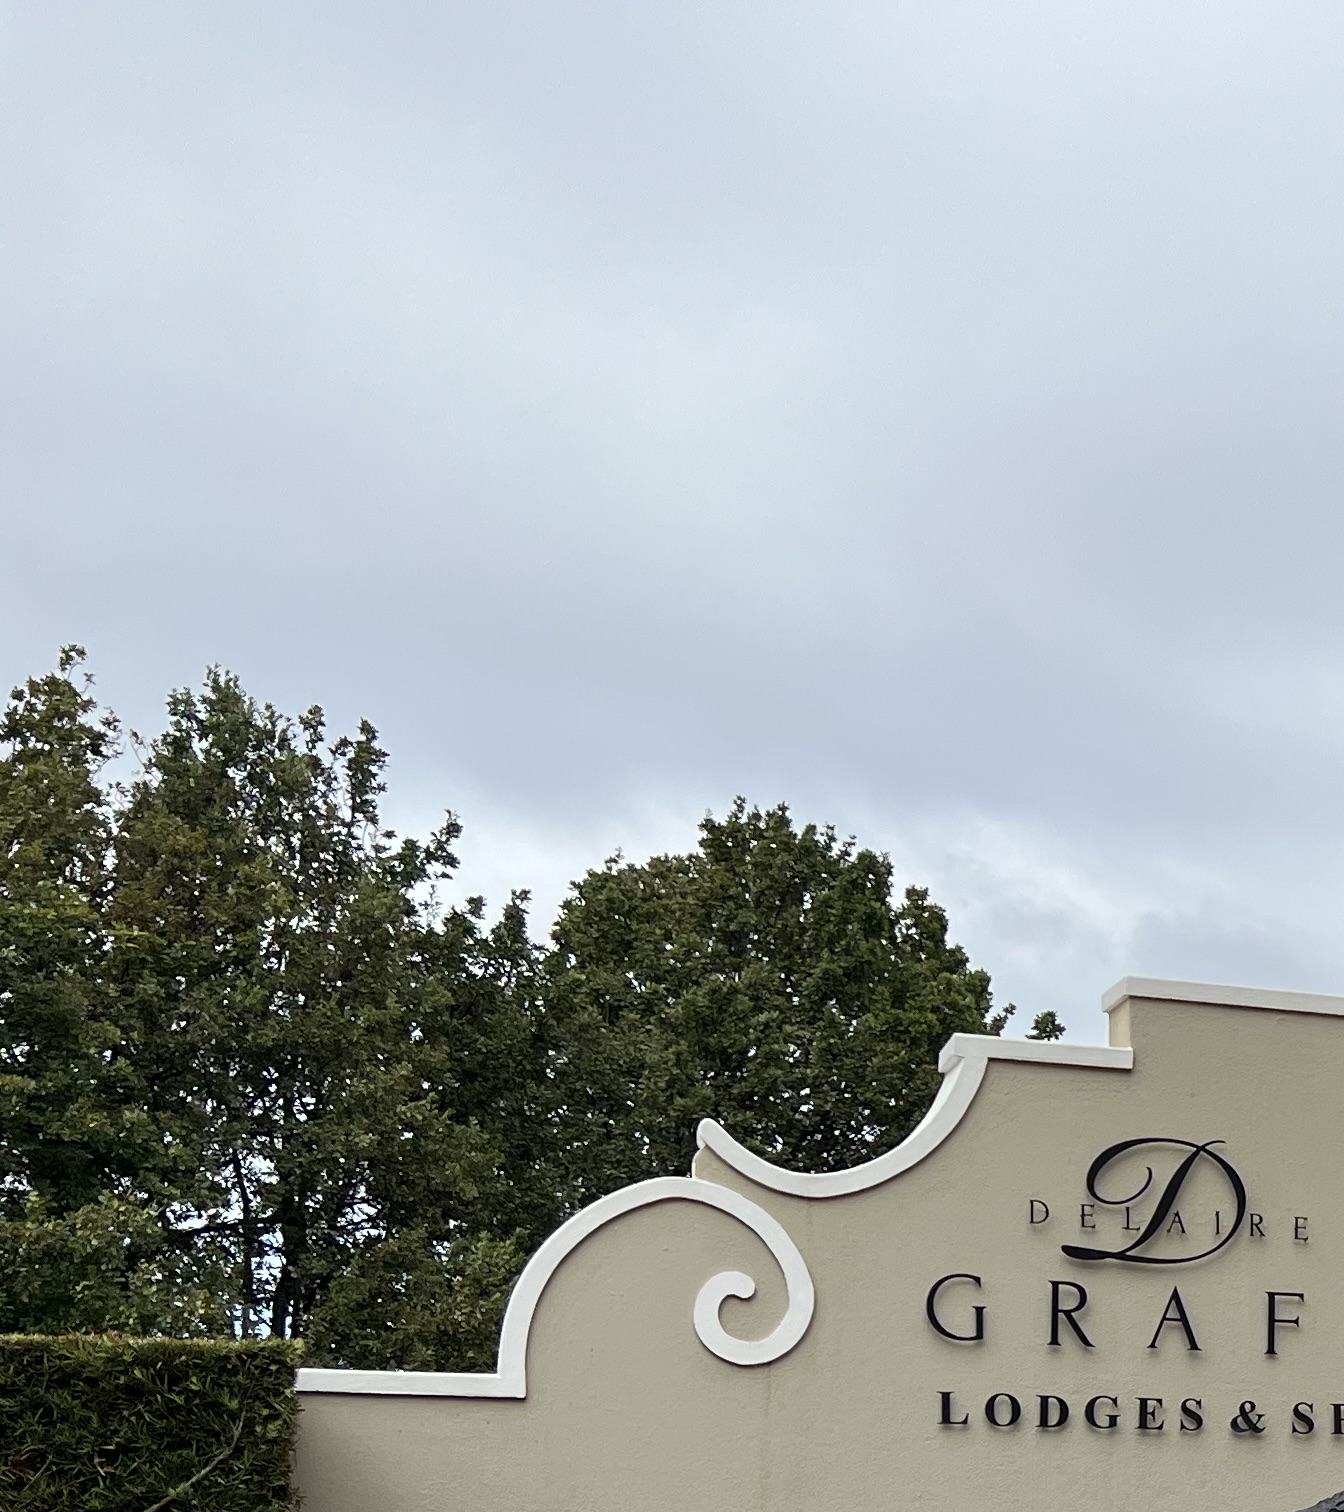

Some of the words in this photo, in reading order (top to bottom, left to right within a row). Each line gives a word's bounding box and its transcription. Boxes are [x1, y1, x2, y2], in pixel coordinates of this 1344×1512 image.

[1029, 1199, 1309, 1241] DELAIRE
[936, 1391, 1204, 1433] LODGES
[1230, 1400, 1266, 1434] &
